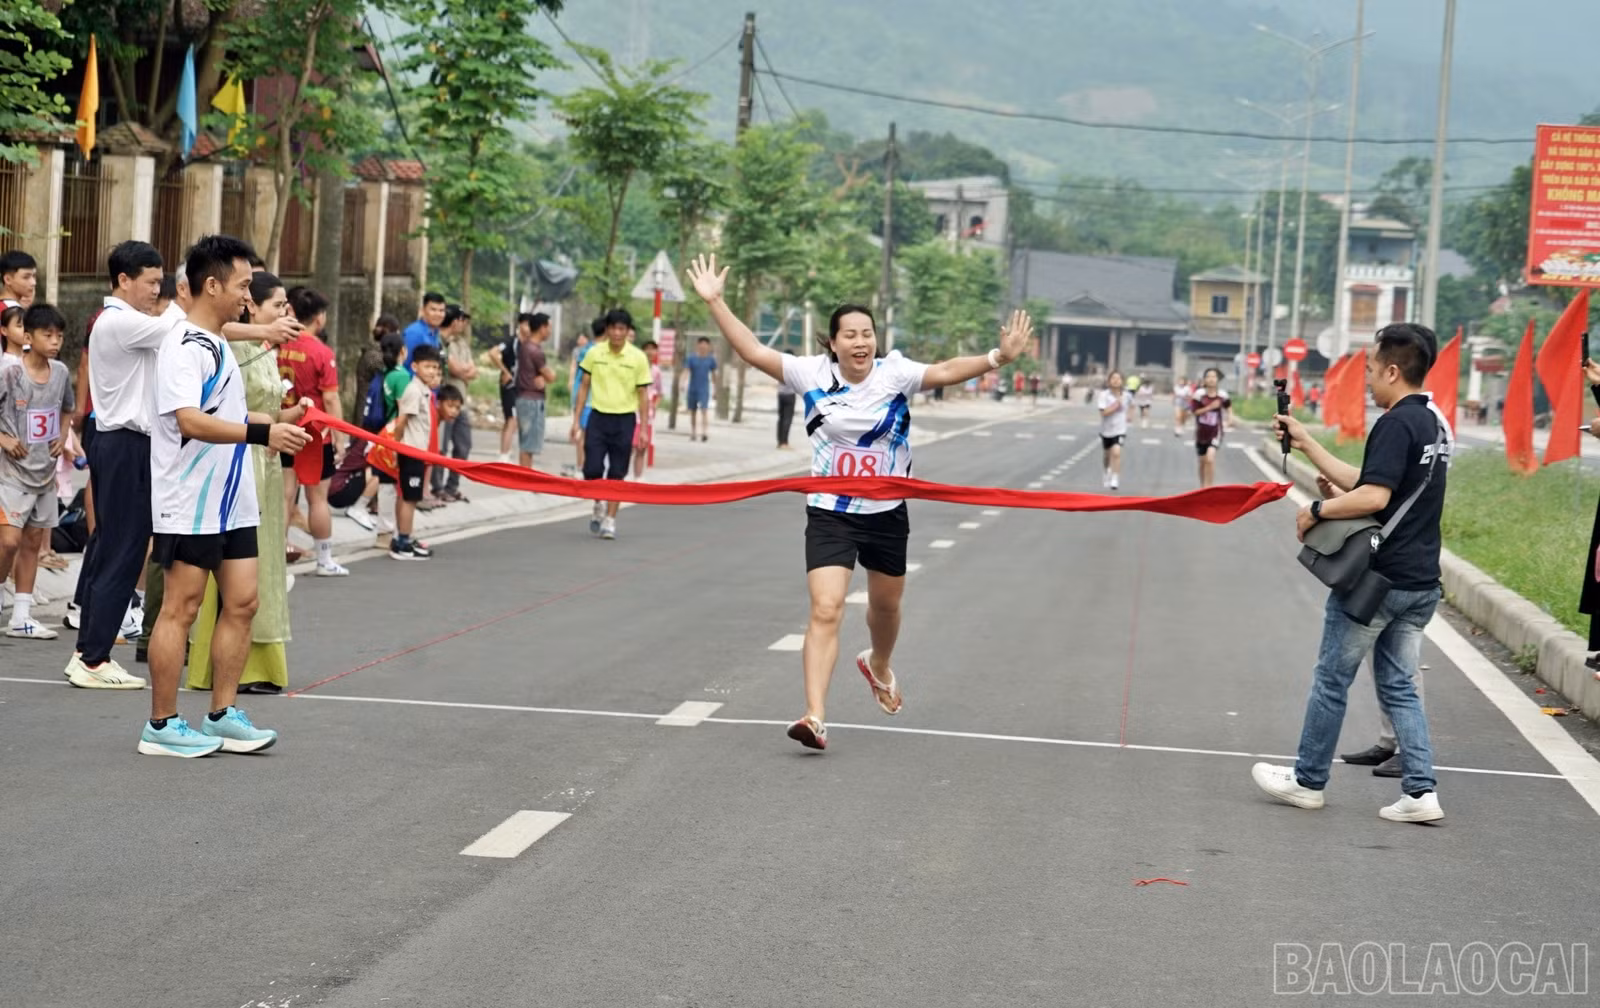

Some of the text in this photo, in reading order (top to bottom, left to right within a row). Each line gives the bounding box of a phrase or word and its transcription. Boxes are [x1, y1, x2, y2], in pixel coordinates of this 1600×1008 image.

[1547, 185, 1585, 201] KHÔNG
[33, 412, 55, 438] 37
[837, 452, 877, 477] 08
